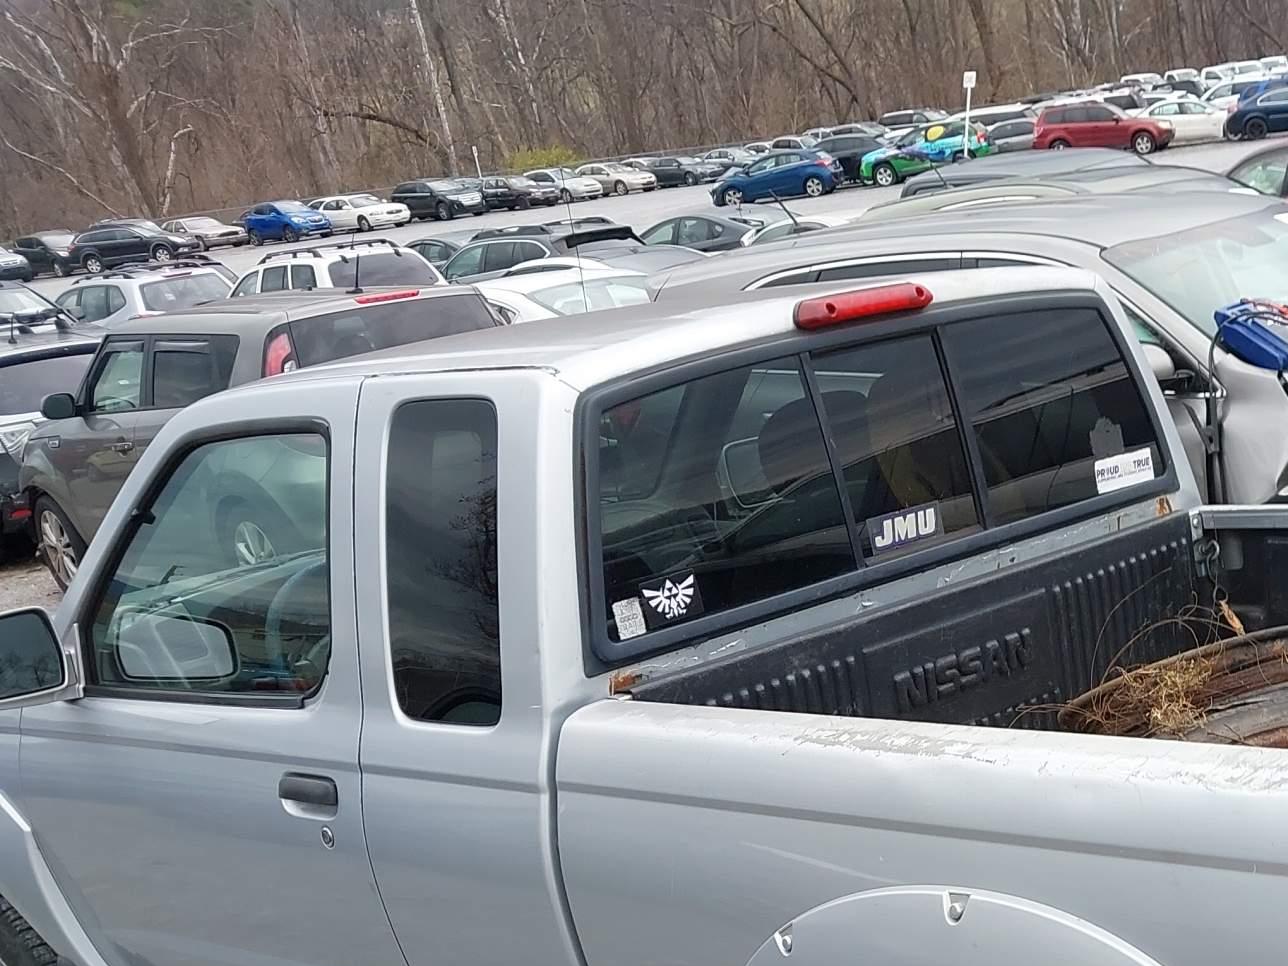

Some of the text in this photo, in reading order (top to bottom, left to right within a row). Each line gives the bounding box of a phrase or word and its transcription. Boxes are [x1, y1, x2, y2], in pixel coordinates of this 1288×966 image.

[1132, 456, 1150, 470] TRUE
[874, 507, 936, 547] JMU
[893, 627, 1033, 711] NISSAN
